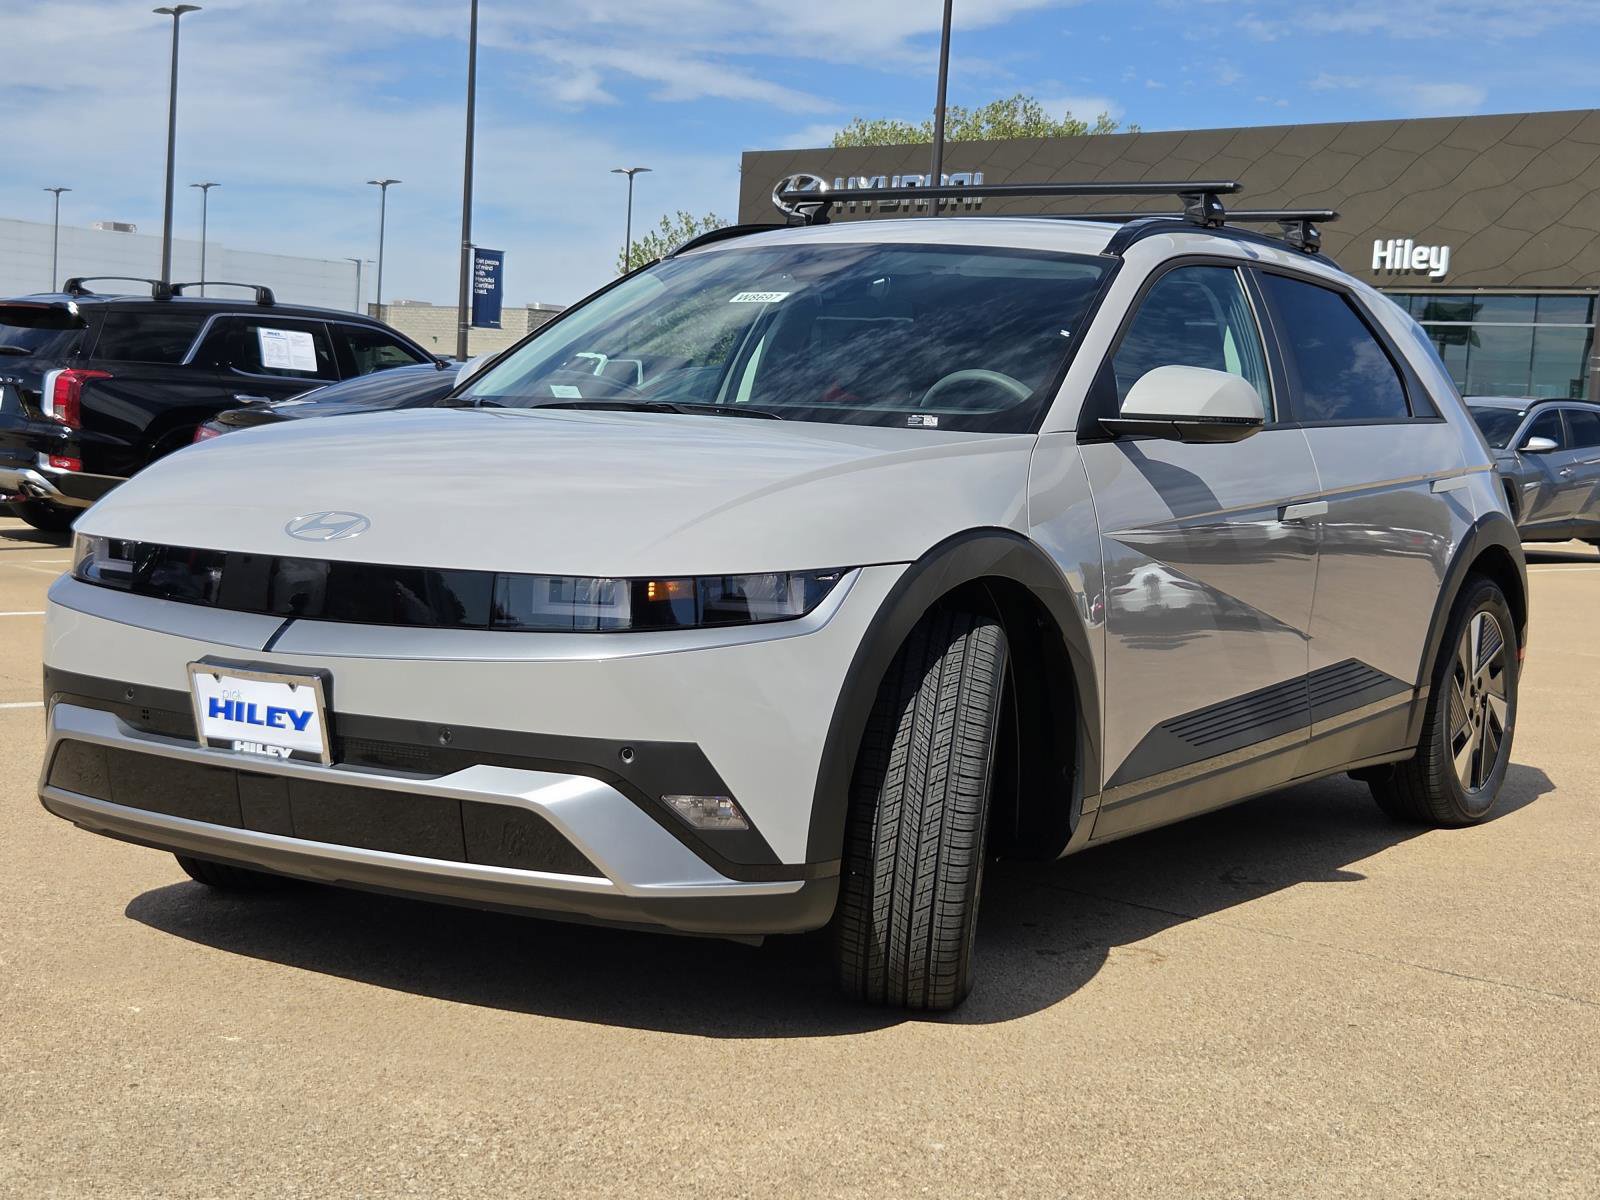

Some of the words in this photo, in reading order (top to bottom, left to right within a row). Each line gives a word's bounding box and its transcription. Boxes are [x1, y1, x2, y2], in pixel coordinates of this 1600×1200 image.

[1372, 239, 1449, 276] Hiley
[208, 696, 314, 732] HILEY
[233, 740, 294, 759] HILEY
